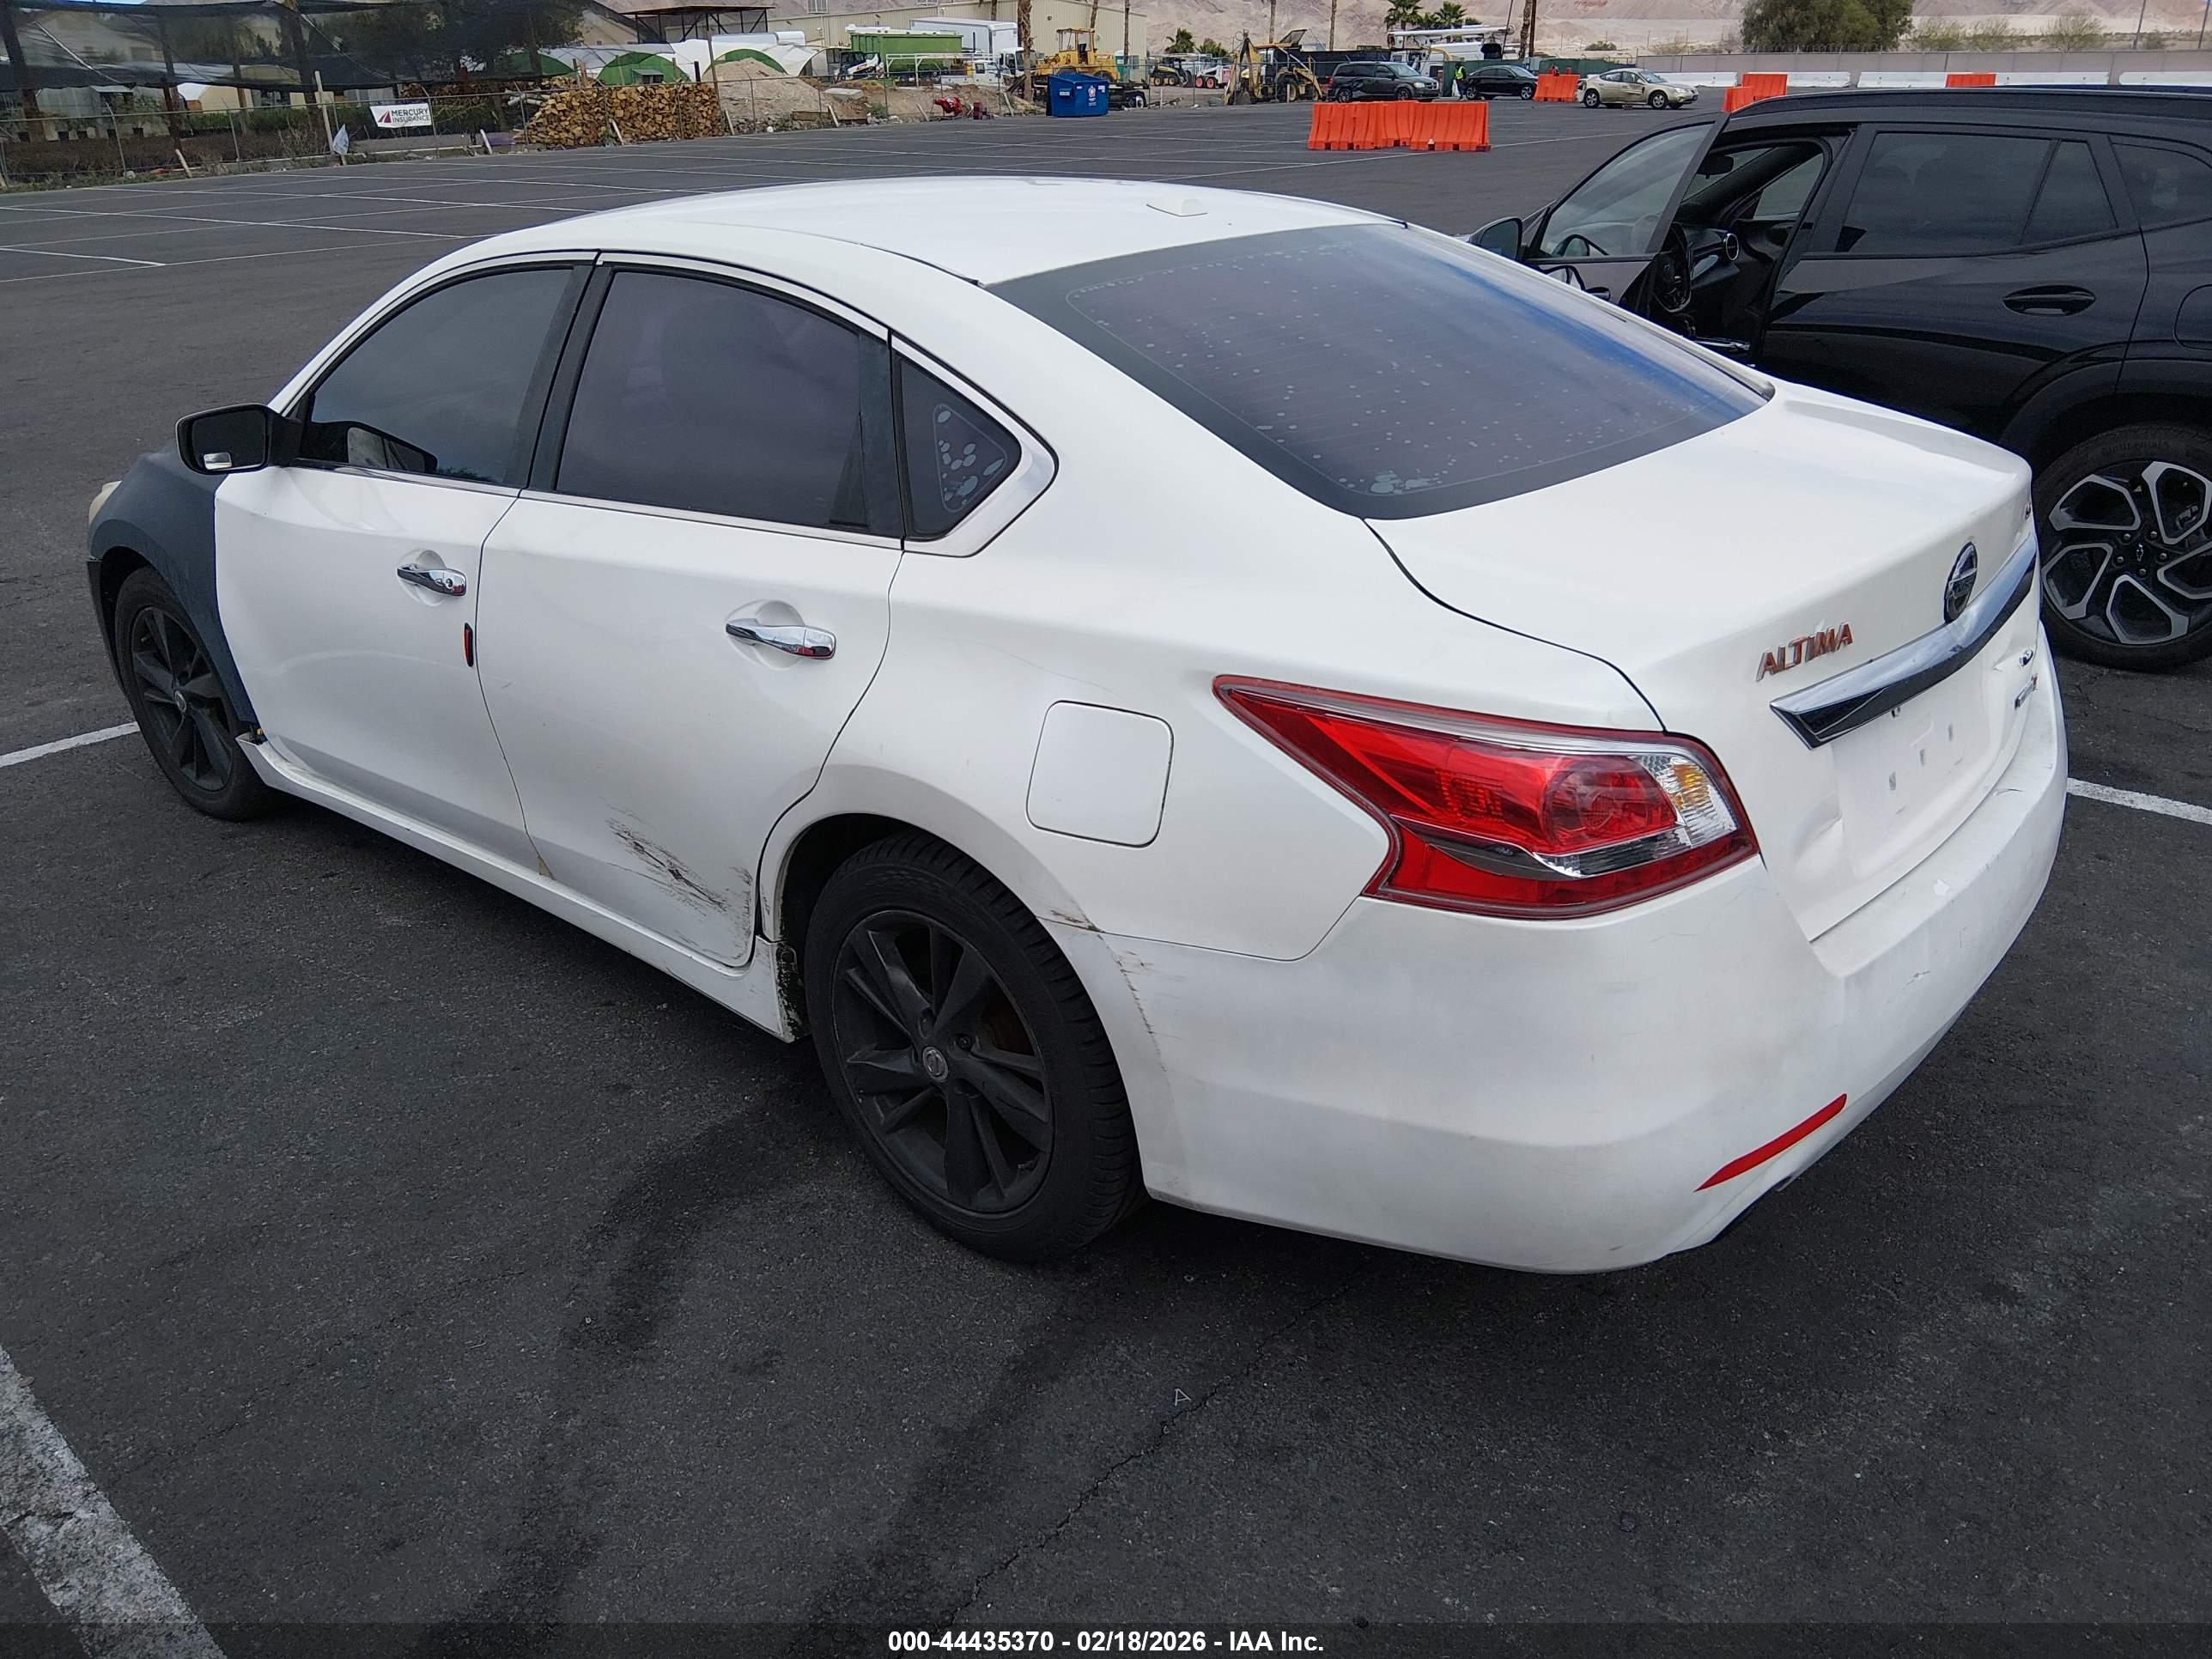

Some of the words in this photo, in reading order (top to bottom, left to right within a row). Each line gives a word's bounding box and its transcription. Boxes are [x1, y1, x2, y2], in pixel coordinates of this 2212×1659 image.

[392, 107, 428, 117] MERCURY
[392, 114, 431, 123] INSURANCE
[1755, 621, 1854, 683] ALTIMA
